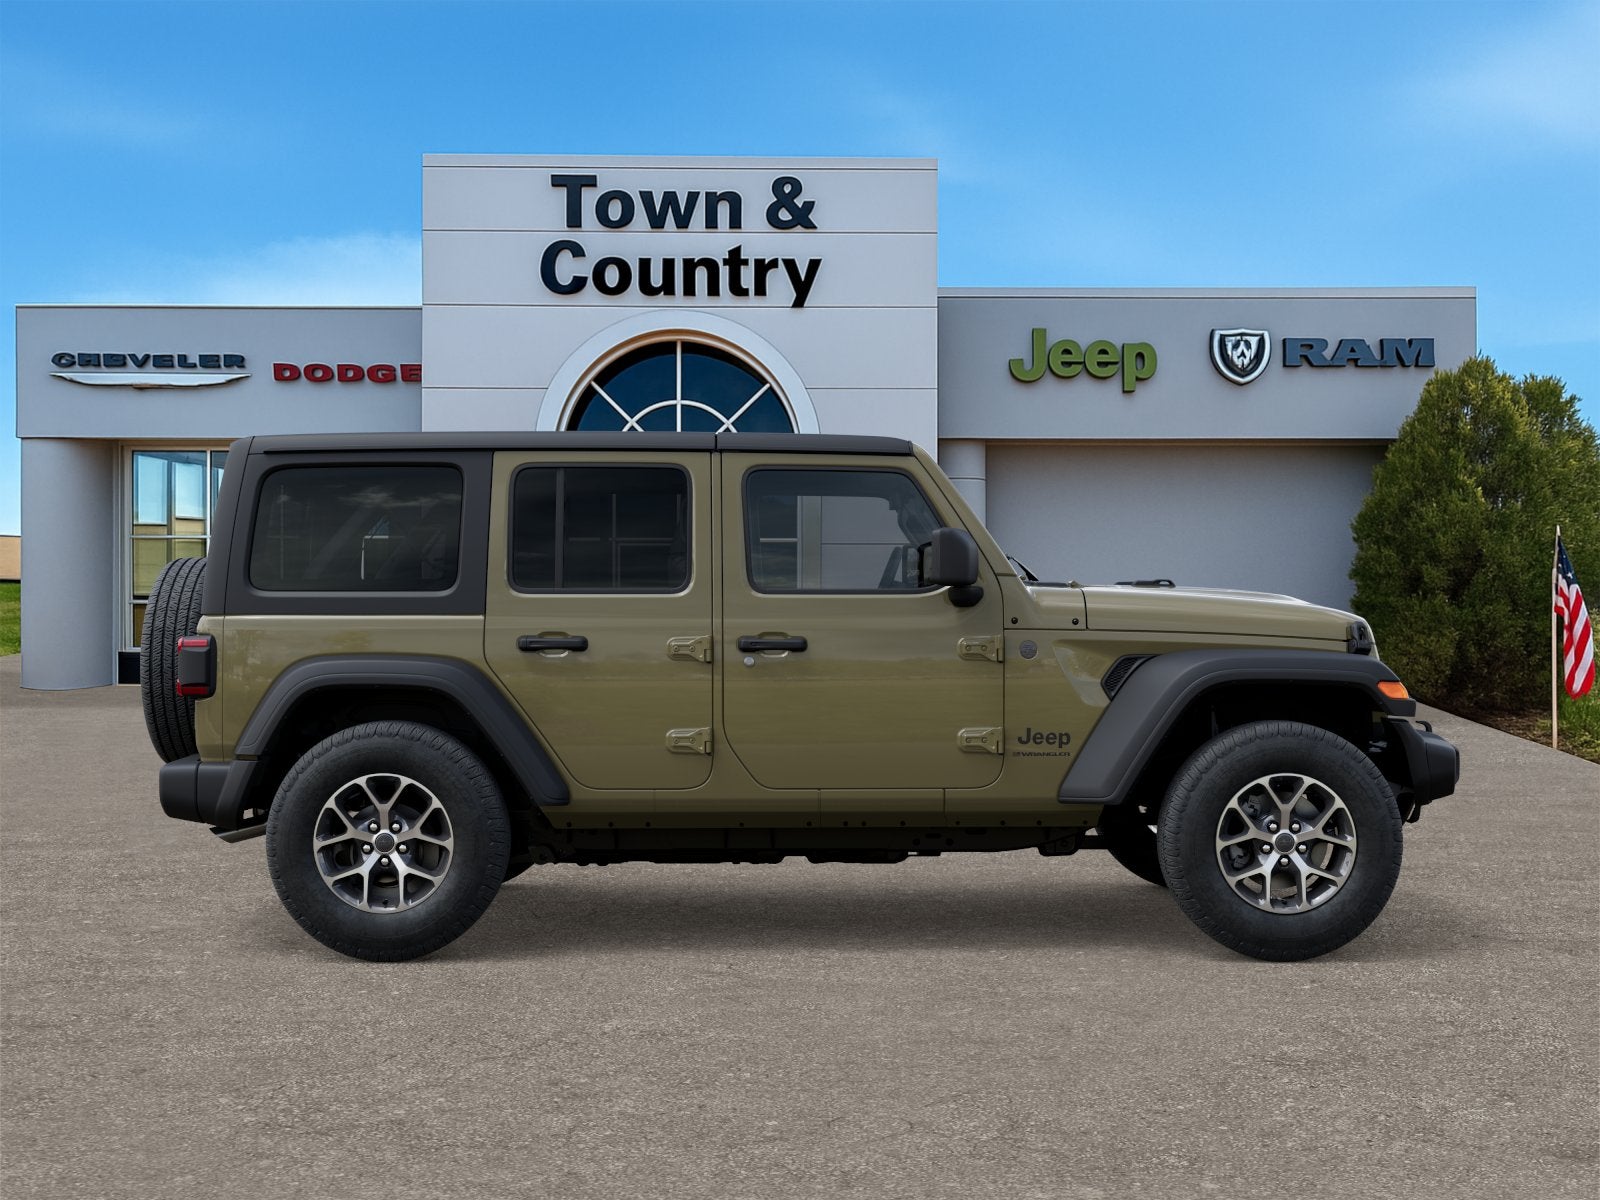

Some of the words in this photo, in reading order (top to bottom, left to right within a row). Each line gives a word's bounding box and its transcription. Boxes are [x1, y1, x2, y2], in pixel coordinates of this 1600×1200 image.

[551, 174, 742, 230] Town
[765, 176, 818, 230] &
[540, 239, 822, 309] Country
[272, 363, 422, 383] DODGE
[1008, 327, 1158, 393] Jeep
[1282, 337, 1436, 368] RAM
[1017, 727, 1071, 749] Jeep
